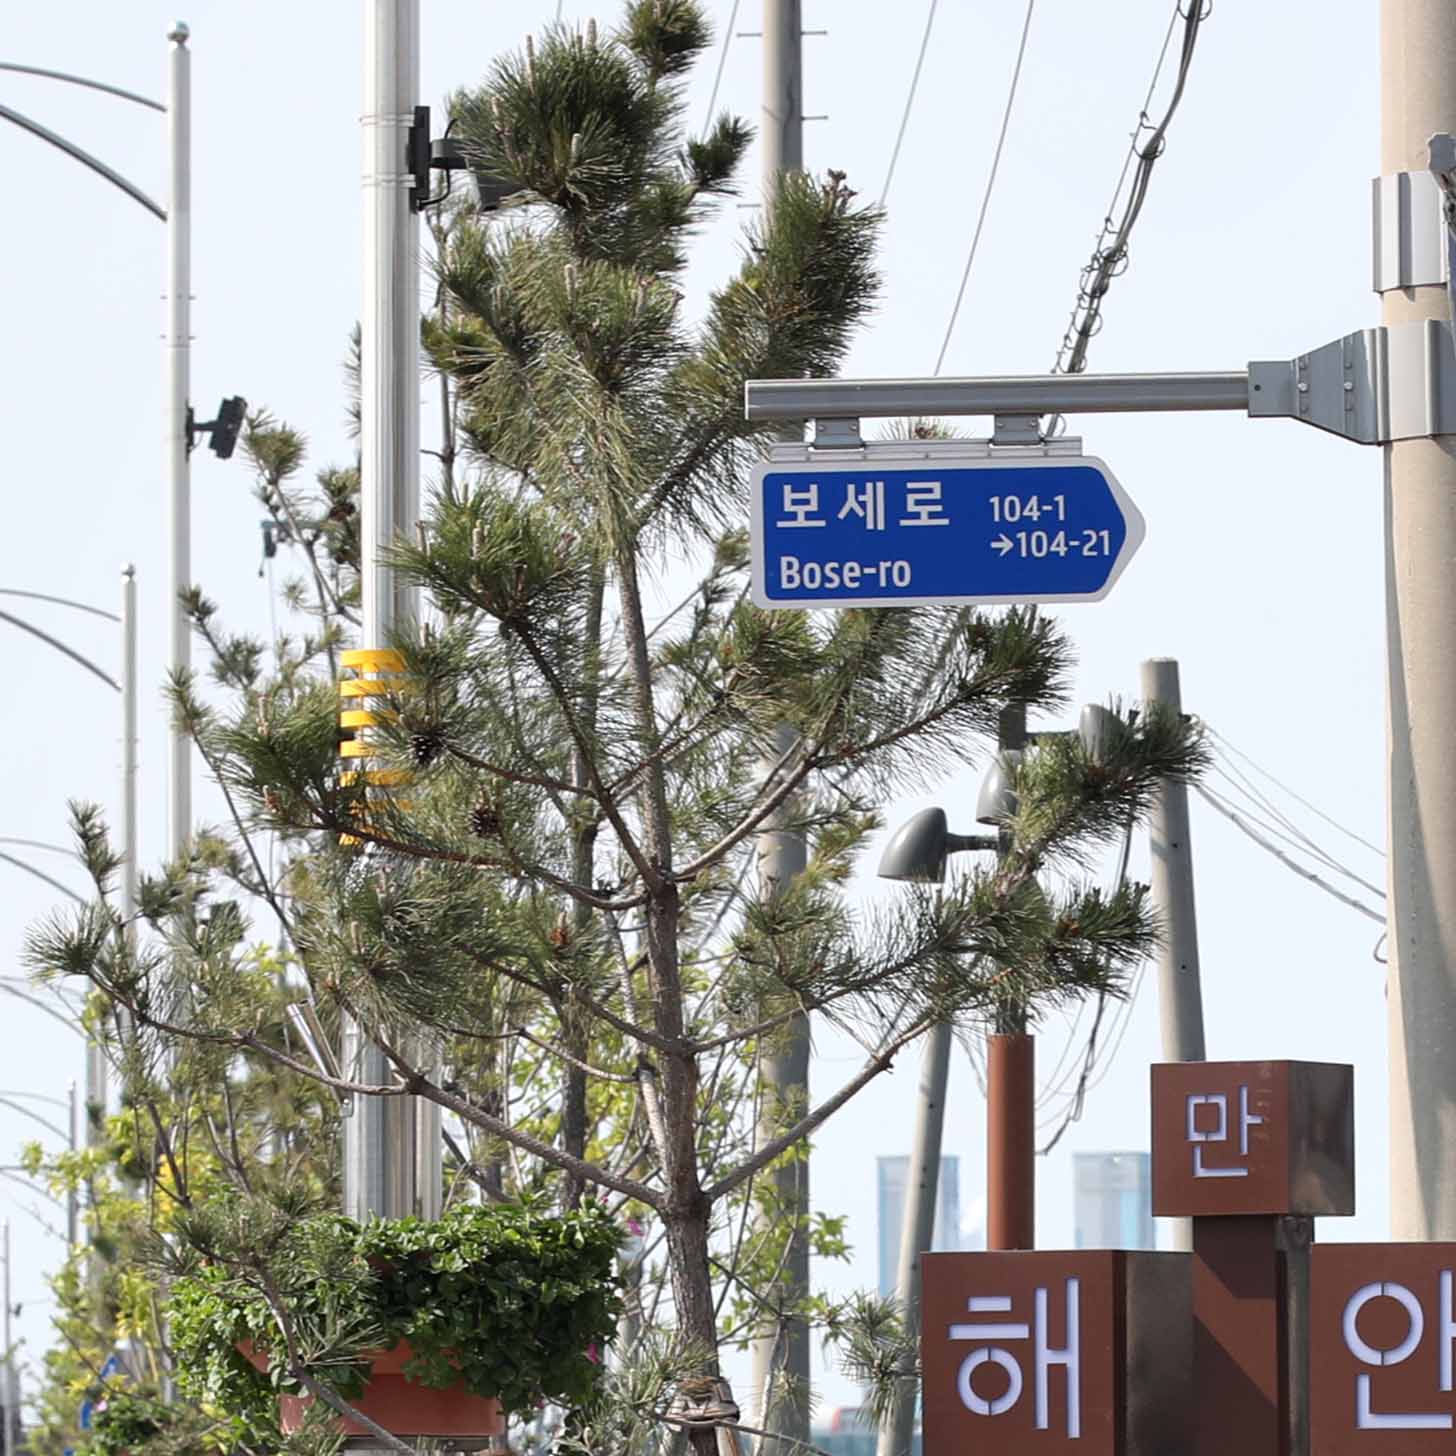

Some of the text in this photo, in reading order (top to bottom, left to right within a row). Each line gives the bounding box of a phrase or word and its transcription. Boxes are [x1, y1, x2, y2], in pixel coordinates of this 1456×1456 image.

[776, 481, 950, 530] 보세로
[989, 495, 1065, 522] 104-1
[1016, 529, 1110, 558] 104-21
[780, 556, 911, 589] Bose-ro
